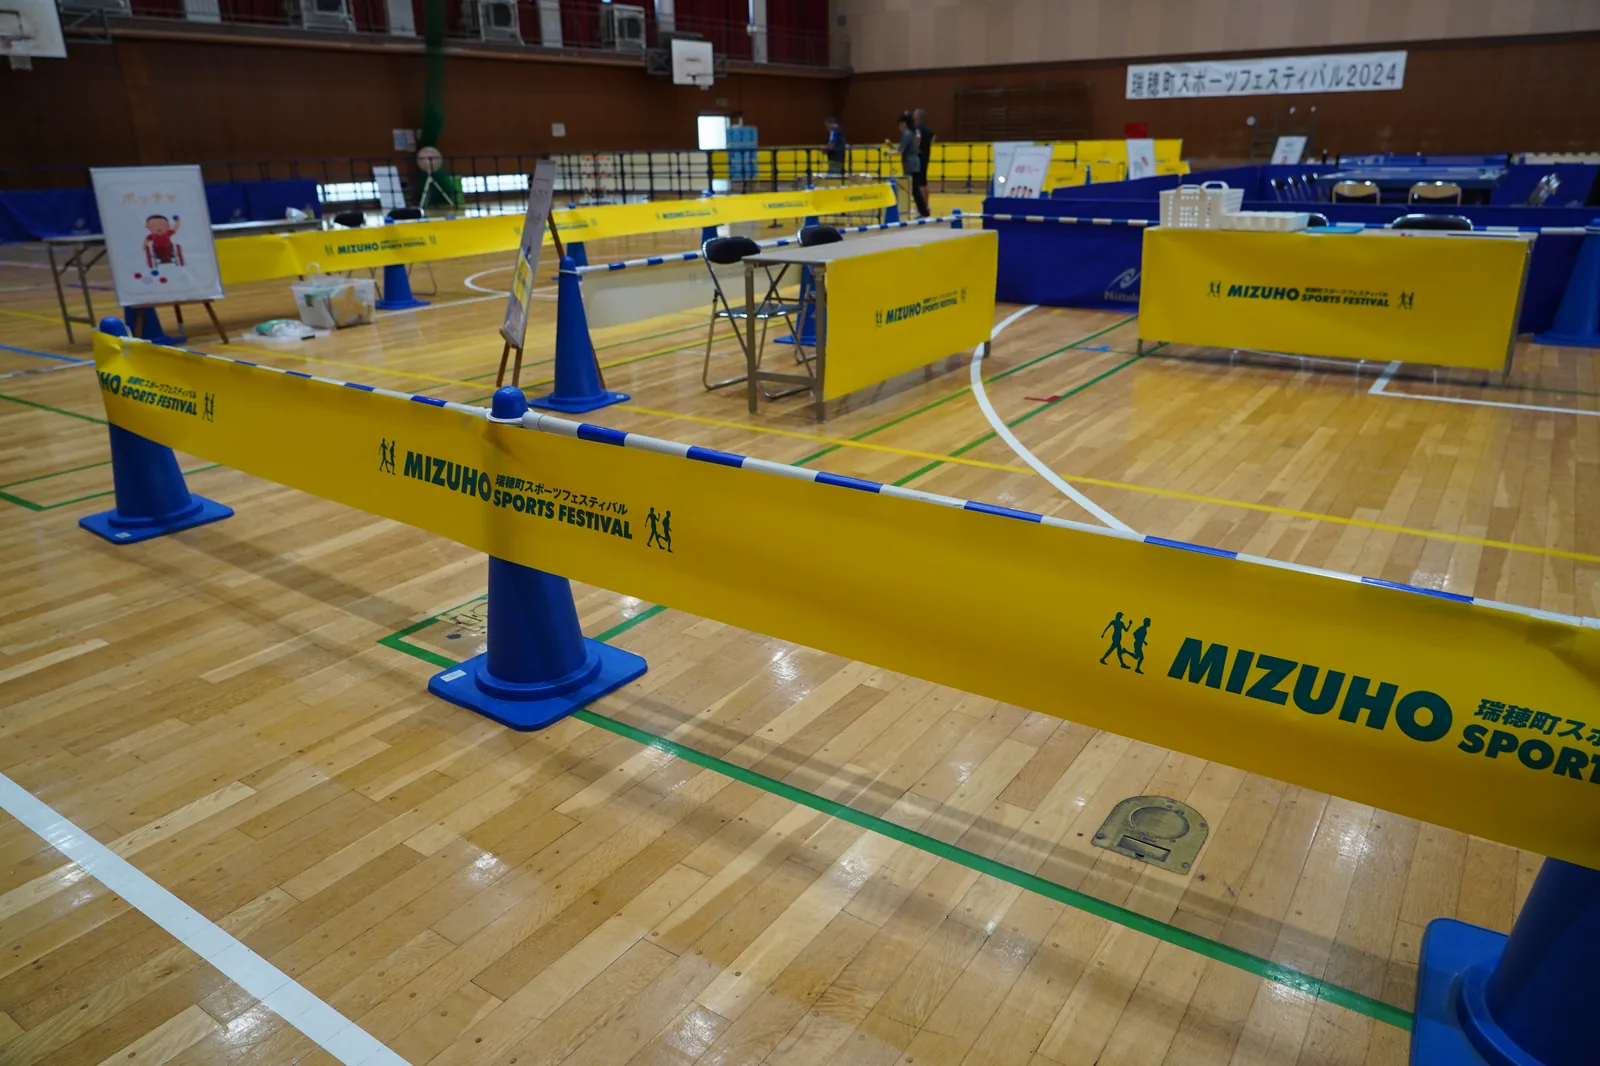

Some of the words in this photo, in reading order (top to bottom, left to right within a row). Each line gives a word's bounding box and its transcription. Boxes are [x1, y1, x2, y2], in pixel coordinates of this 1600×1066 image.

[338, 242, 379, 254] MIZUHO
[1227, 285, 1300, 301] MIZUHO
[1301, 293, 1341, 304] SPORTS
[1343, 296, 1389, 307] FESTIVAL
[885, 301, 921, 324] MIZUHO
[96, 370, 122, 395] HO
[121, 385, 157, 405] SPORTS
[156, 394, 198, 416] FESTIVAL
[404, 451, 492, 502] MIZUHO
[495, 474, 628, 516] 瑞穂町スポーツフェスティバル
[493, 489, 555, 519] SPORTS
[558, 504, 633, 540] FESTIVAL
[1167, 637, 1453, 743] MIZUHO
